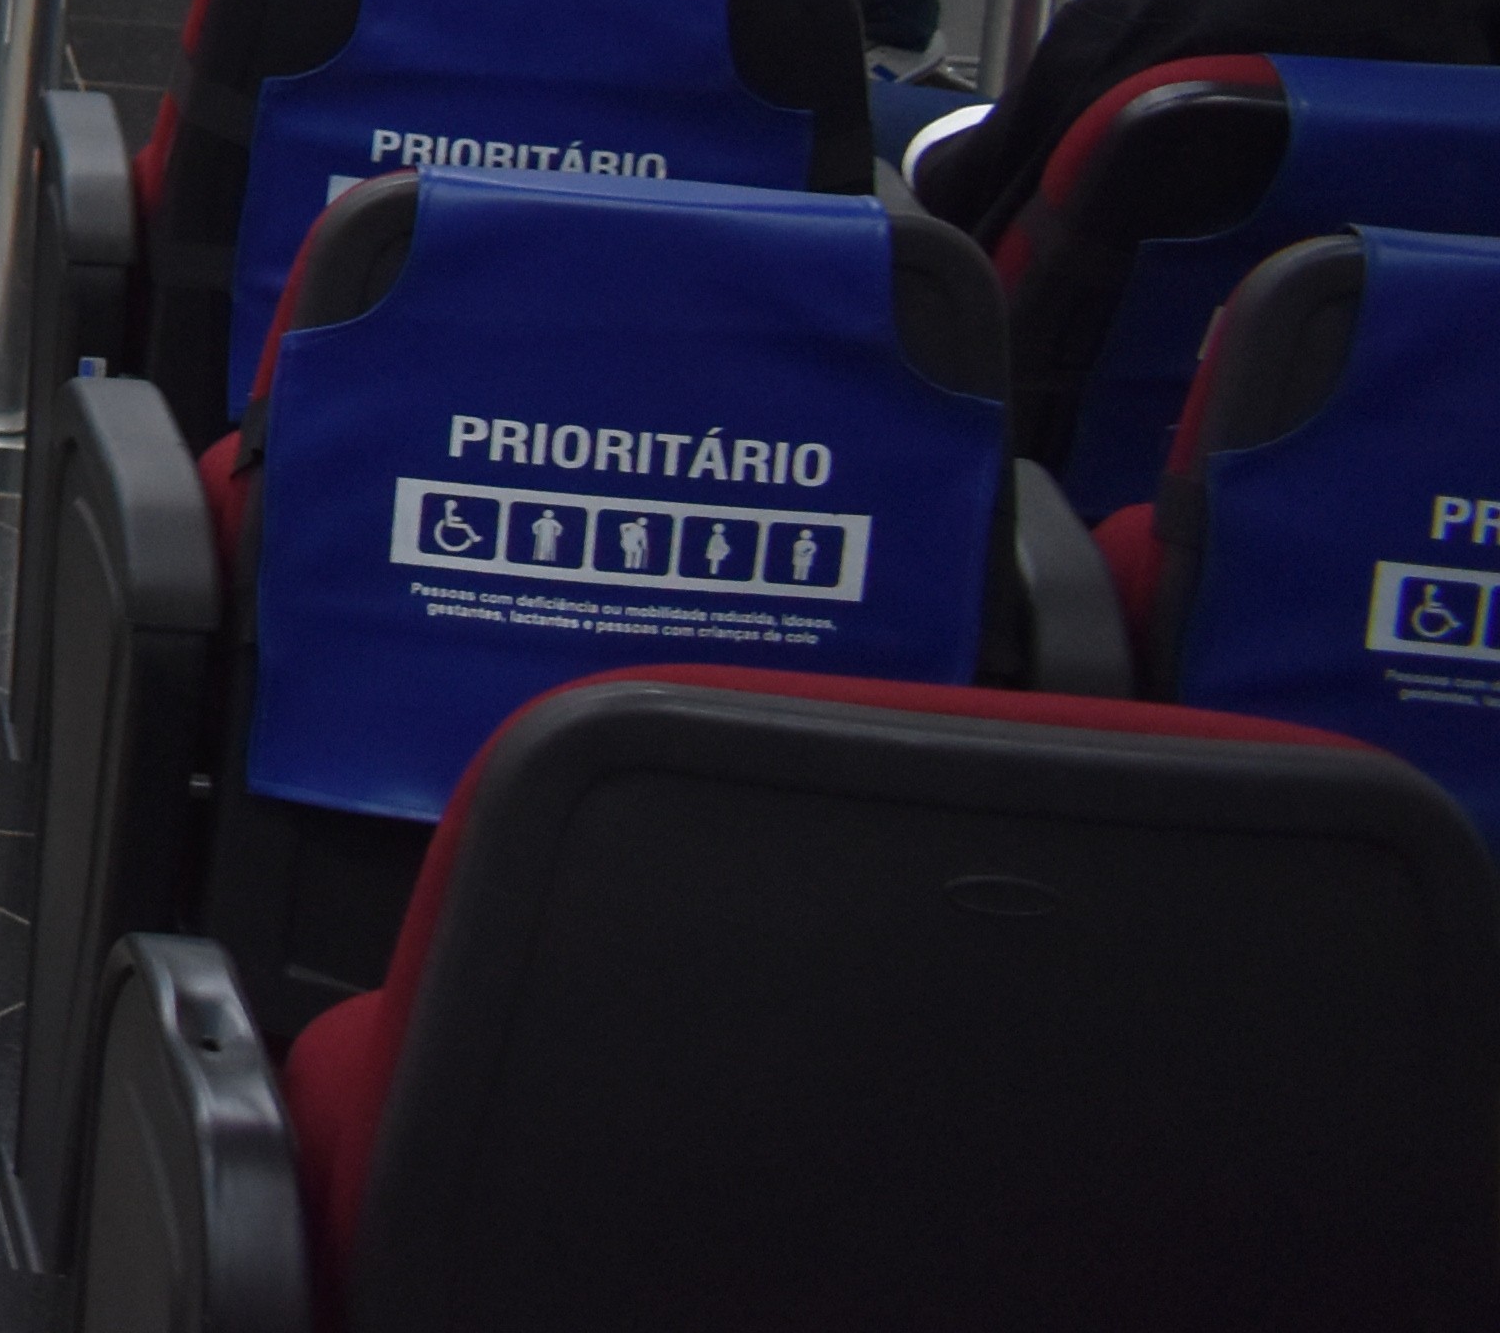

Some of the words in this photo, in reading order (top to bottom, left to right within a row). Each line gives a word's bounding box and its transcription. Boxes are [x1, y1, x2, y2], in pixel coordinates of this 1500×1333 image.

[370, 129, 667, 180] PRIORITÁRIO
[448, 414, 833, 488] PRIORITÁRIO
[411, 582, 476, 601] Pessoas
[479, 593, 514, 605] com
[516, 595, 600, 613] deficiência
[602, 605, 622, 615] ou
[625, 605, 708, 622] mobilidade
[710, 611, 778, 626] reduzida,
[782, 614, 837, 630] idosos,
[427, 603, 506, 623] gestantes,
[510, 610, 580, 629] lactantes
[582, 619, 594, 630] e
[596, 621, 658, 634] pessoas
[661, 626, 695, 637] com
[697, 626, 761, 642] crianças
[763, 629, 783, 642] de
[785, 632, 820, 645] colo
